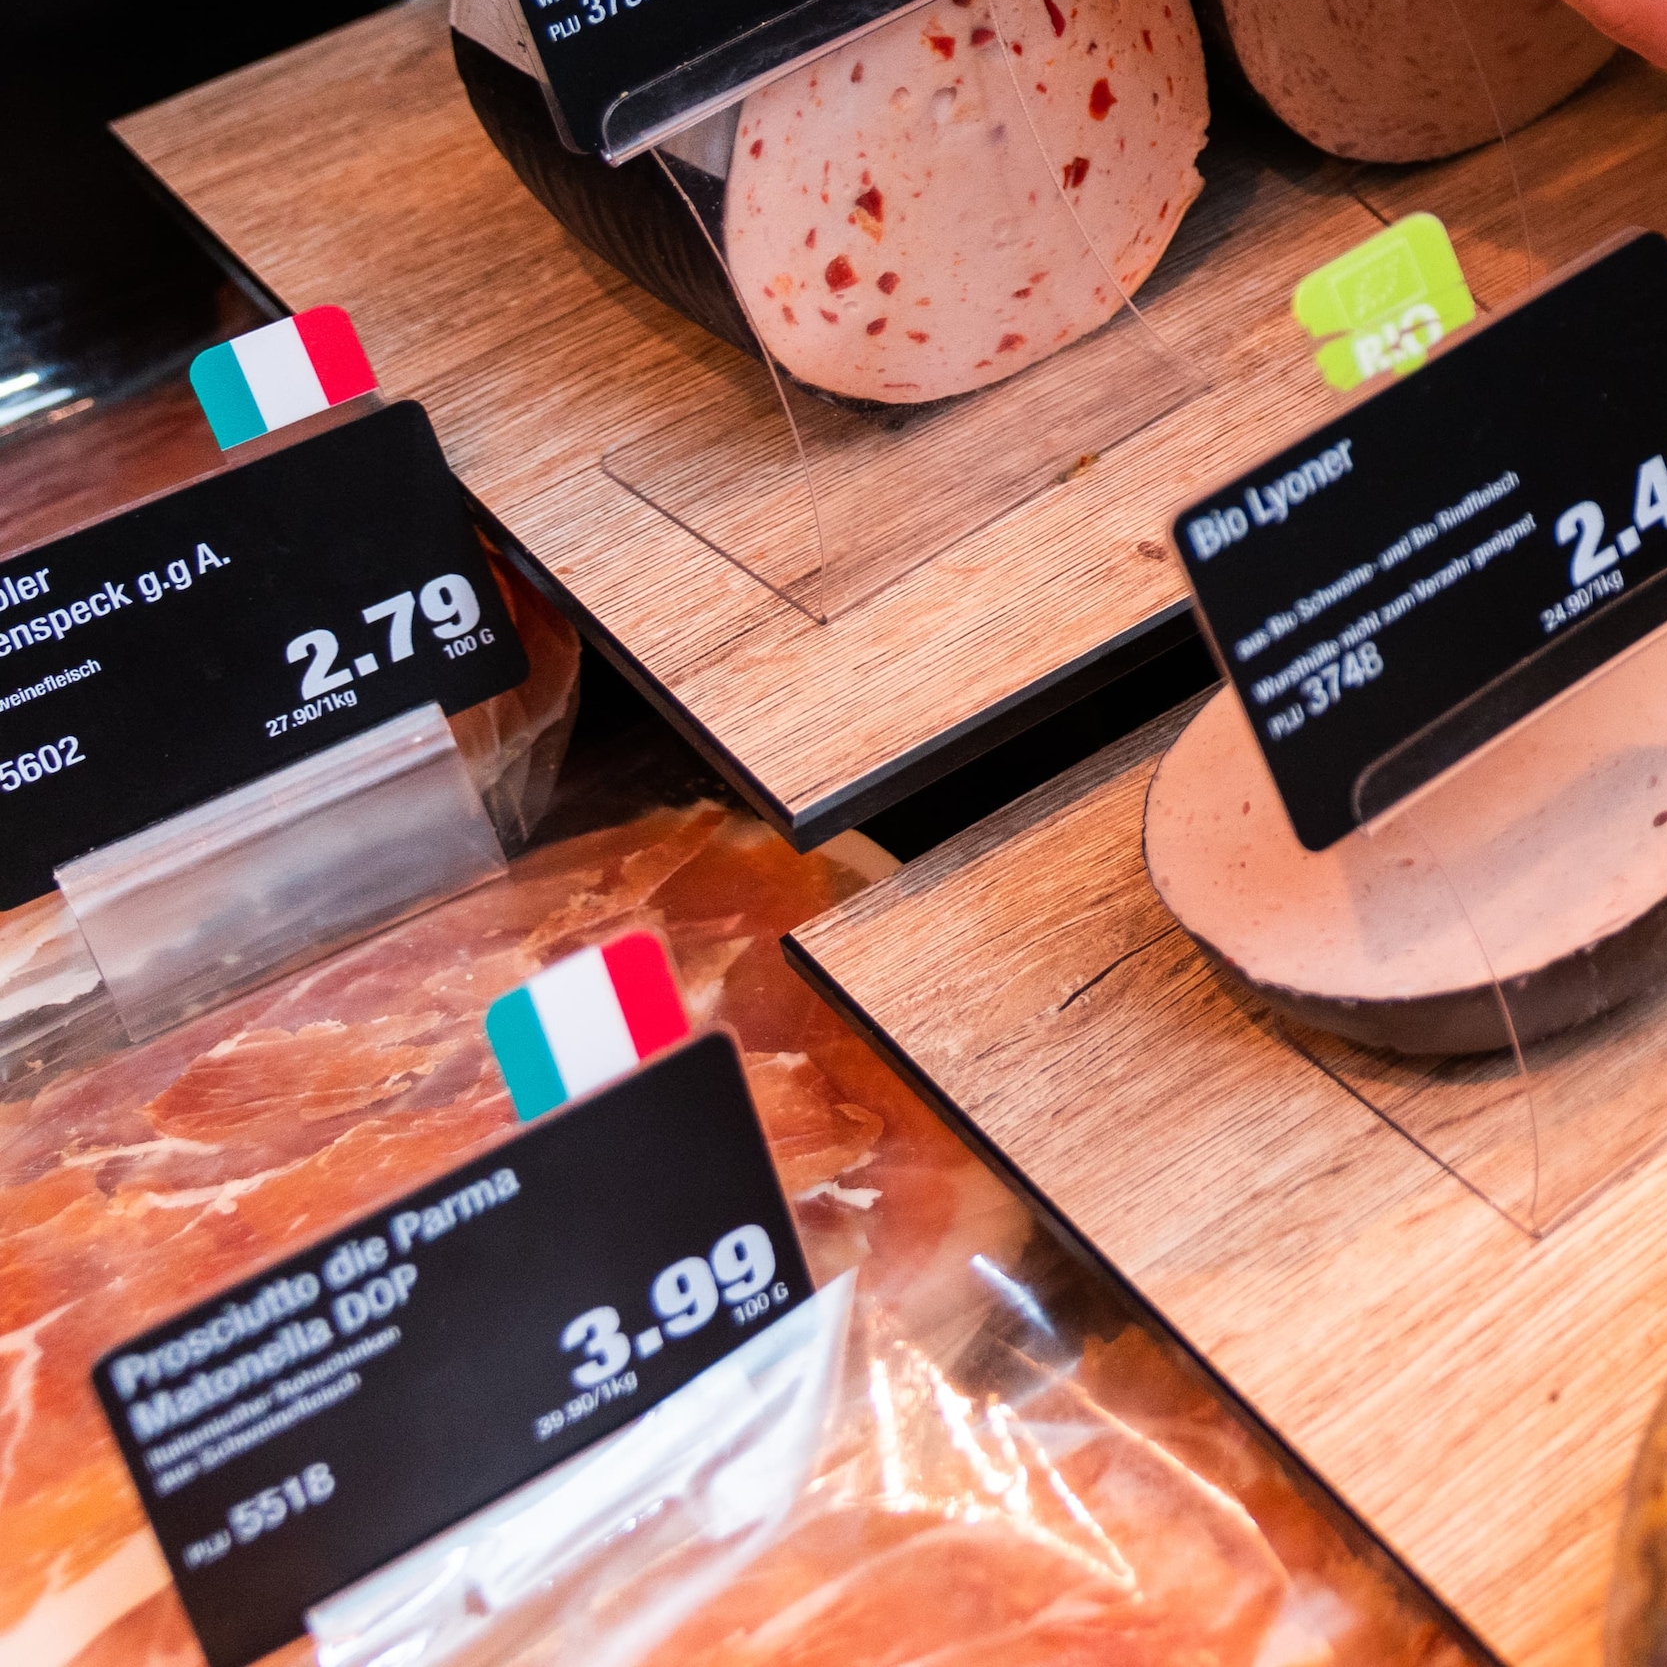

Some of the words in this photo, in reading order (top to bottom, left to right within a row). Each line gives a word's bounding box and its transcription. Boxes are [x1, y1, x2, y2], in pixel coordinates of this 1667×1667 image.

[548, 14, 583, 42] PLU
[1186, 505, 1249, 563] Bio
[1244, 438, 1354, 528] Lyoner
[136, 558, 193, 604] g.g
[196, 542, 232, 575] A.
[1539, 569, 1624, 634] 24.90/1kg
[285, 574, 481, 702] 2.79
[443, 634, 478, 661] 100
[480, 629, 496, 646] G
[265, 688, 358, 738] 27.90/1kg
[1266, 702, 1305, 742] PLU
[1301, 640, 1384, 717] 3748
[0, 735, 86, 792] 5602
[110, 1271, 321, 1400] Prosciutto
[321, 1236, 389, 1291] die
[389, 1167, 522, 1254] Parma
[332, 1263, 419, 1334] DOP
[558, 1223, 777, 1390] 3.99
[731, 1291, 770, 1326] 100
[771, 1281, 789, 1305] G
[534, 1370, 638, 1442] 39.90/1kg
[183, 1530, 233, 1573] PLU
[226, 1462, 337, 1545] 5518
